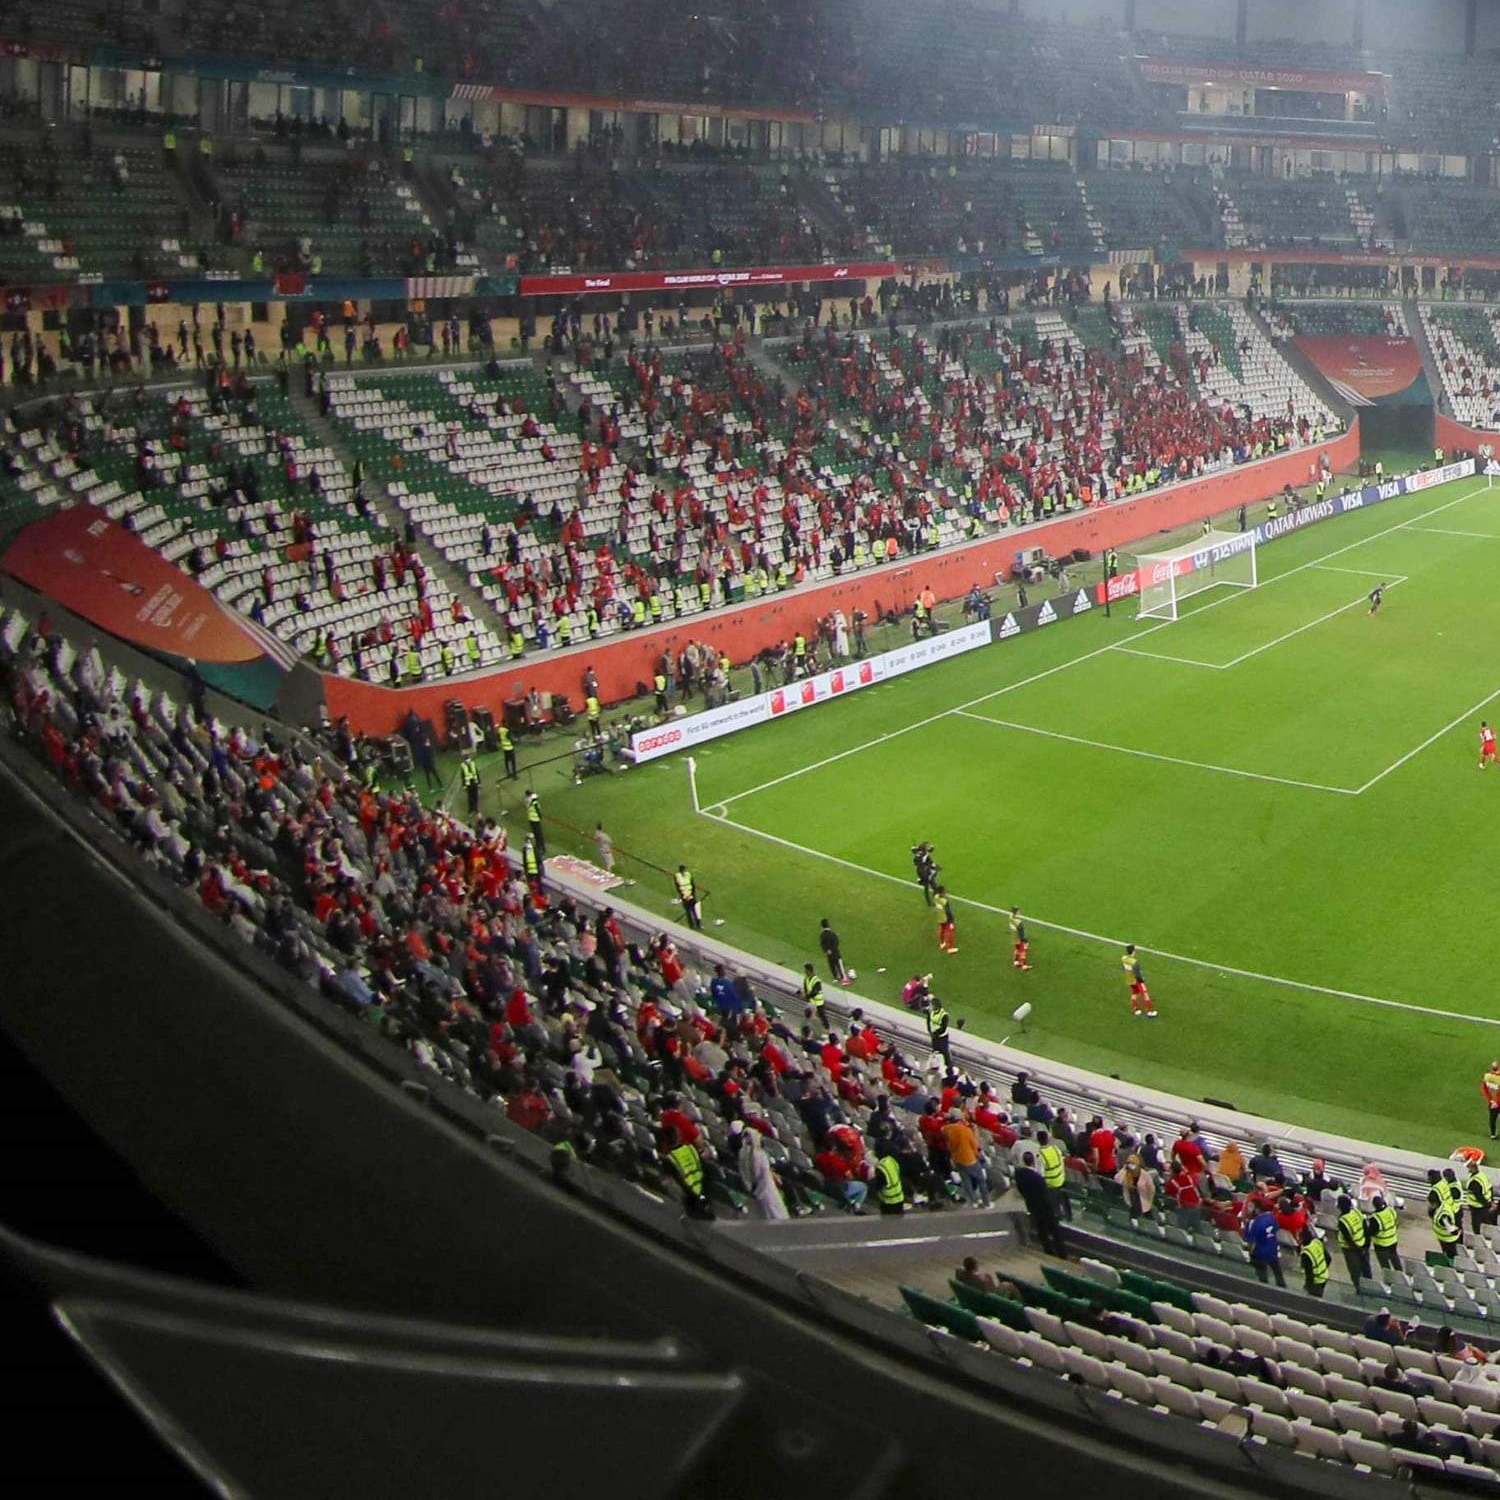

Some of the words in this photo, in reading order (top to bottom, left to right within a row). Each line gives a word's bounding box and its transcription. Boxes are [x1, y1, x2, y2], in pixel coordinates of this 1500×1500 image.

[1340, 492, 1363, 511] VISA
[1376, 482, 1400, 501] VISA
[1264, 514, 1295, 539] QATAR
[1296, 500, 1334, 527] AIRWAYS
[638, 729, 681, 753] ooredoo
